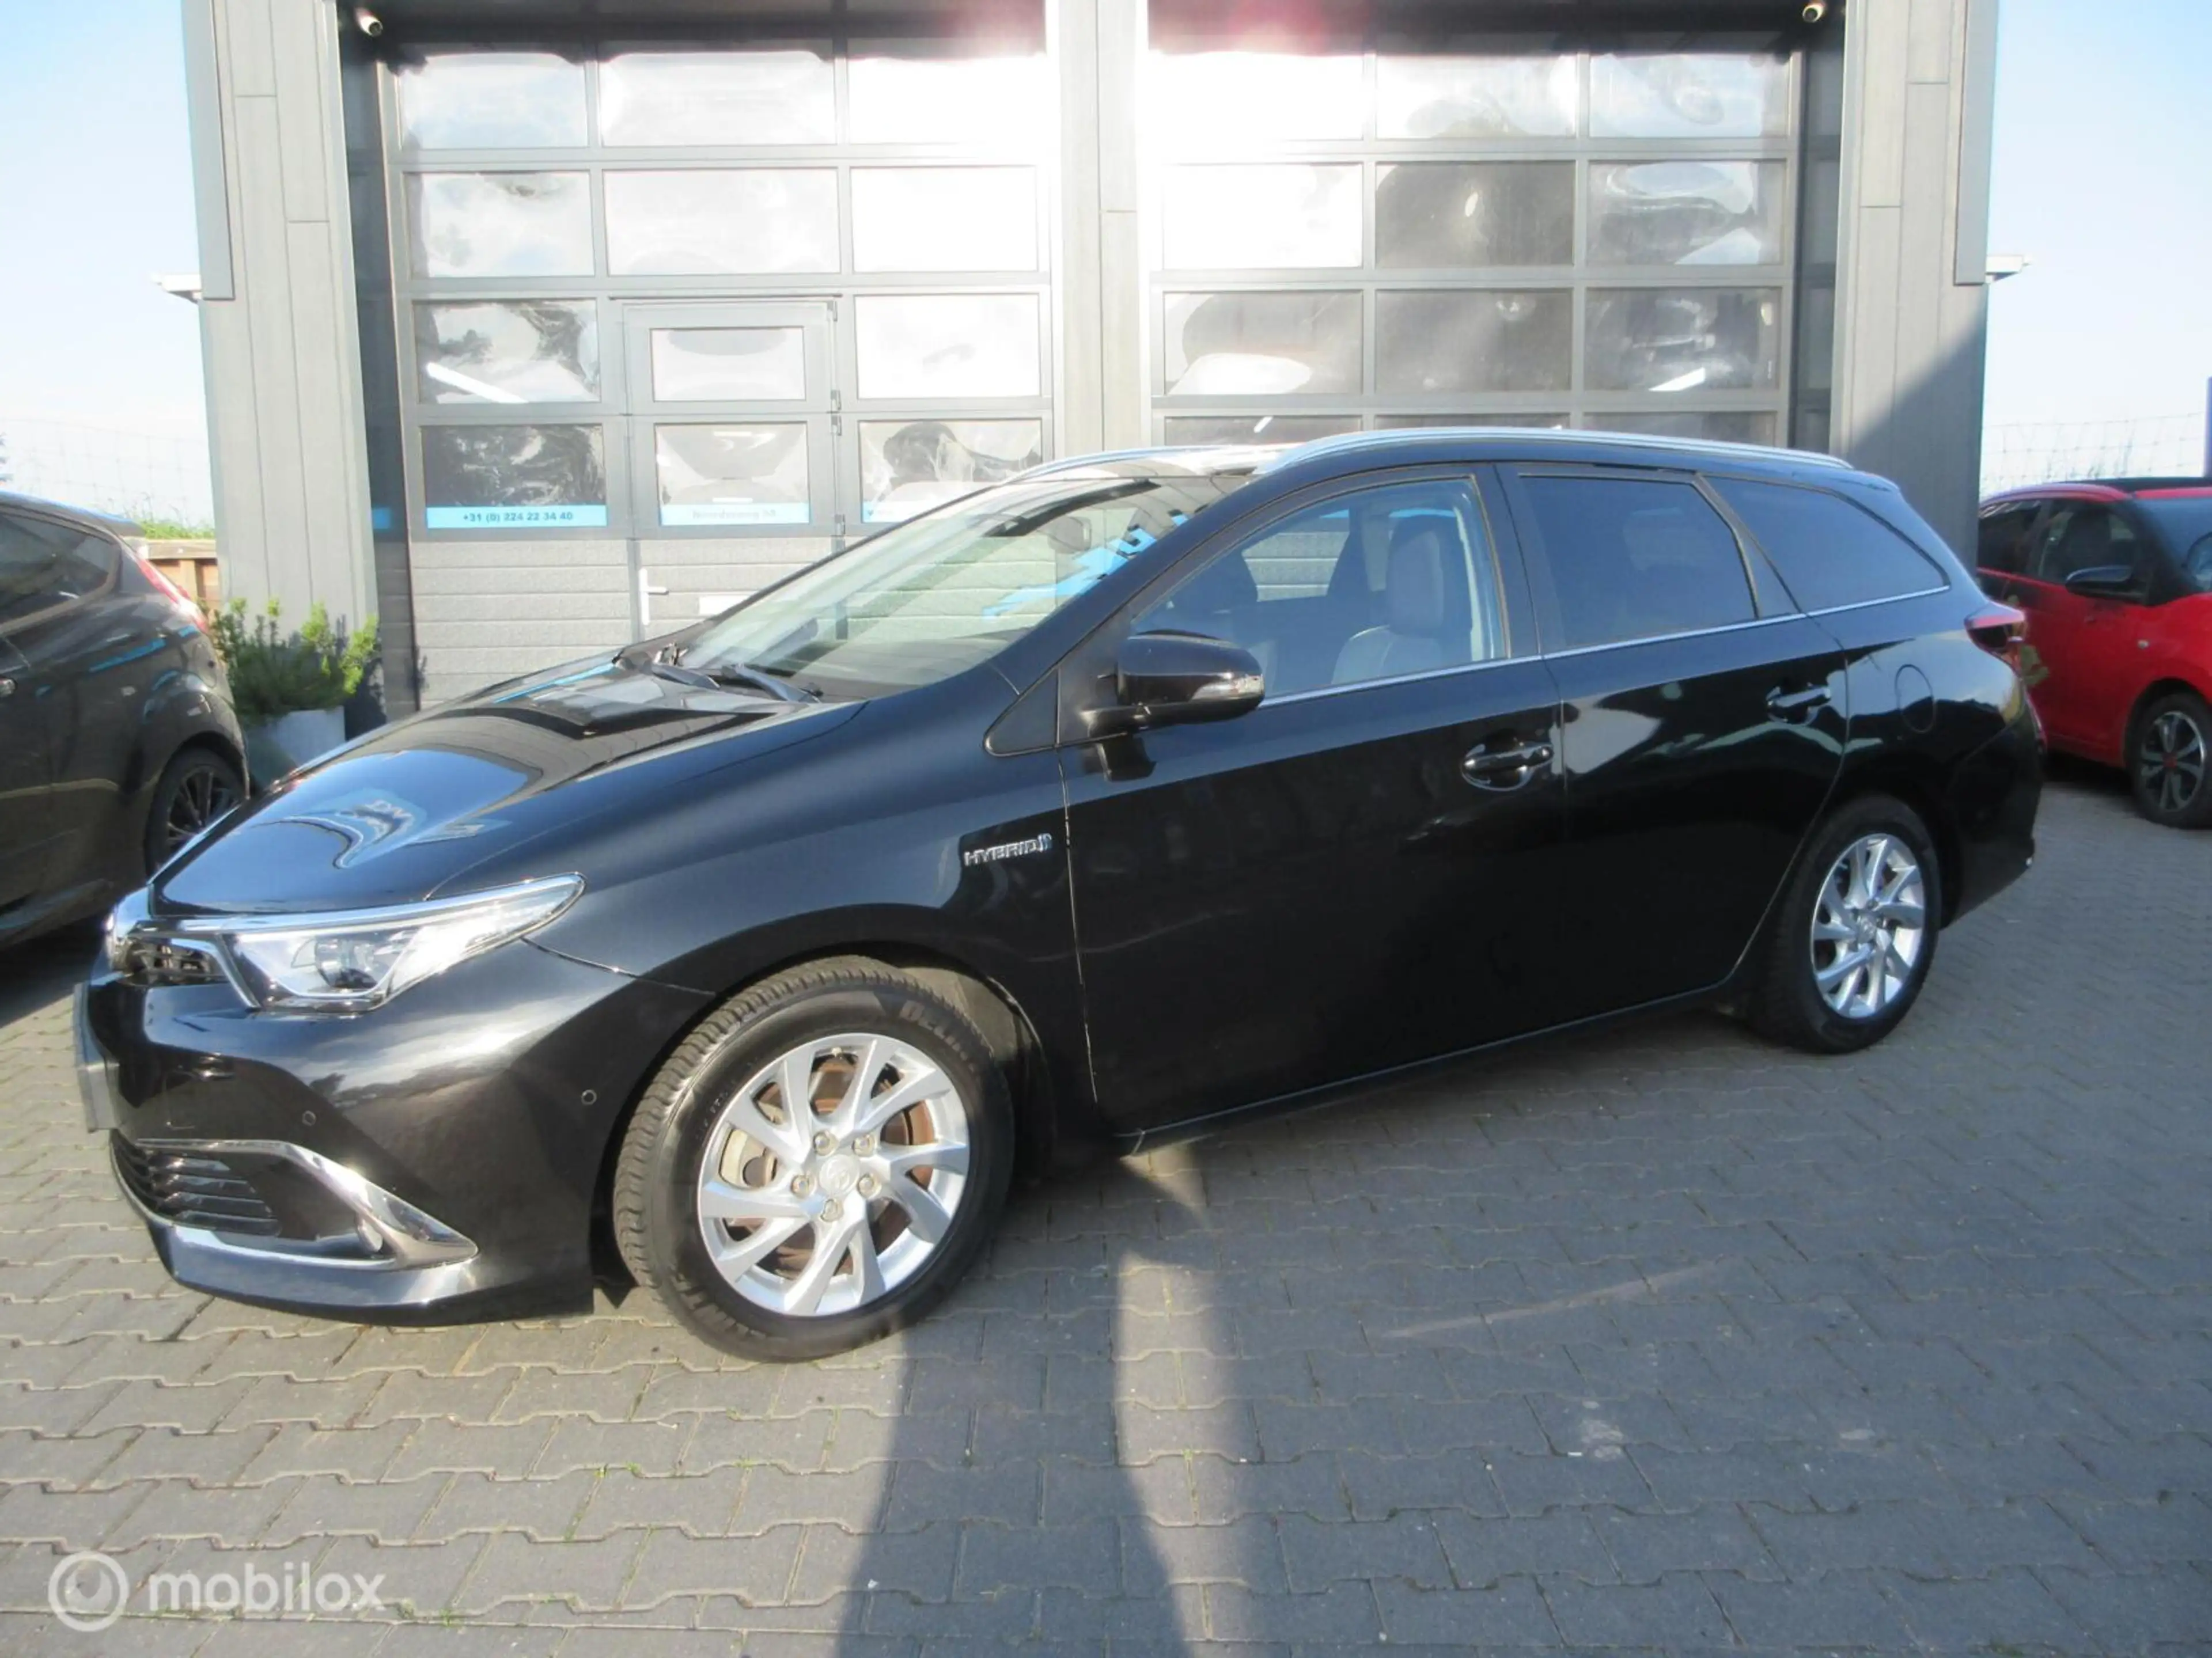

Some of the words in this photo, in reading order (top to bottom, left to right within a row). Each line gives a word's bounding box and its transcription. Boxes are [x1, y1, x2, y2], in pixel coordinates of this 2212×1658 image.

[463, 512, 482, 522] +31
[486, 512, 501, 522] (0)
[543, 511, 557, 521] 34
[559, 511, 574, 521] 40
[964, 838, 1040, 866] HYBRID
